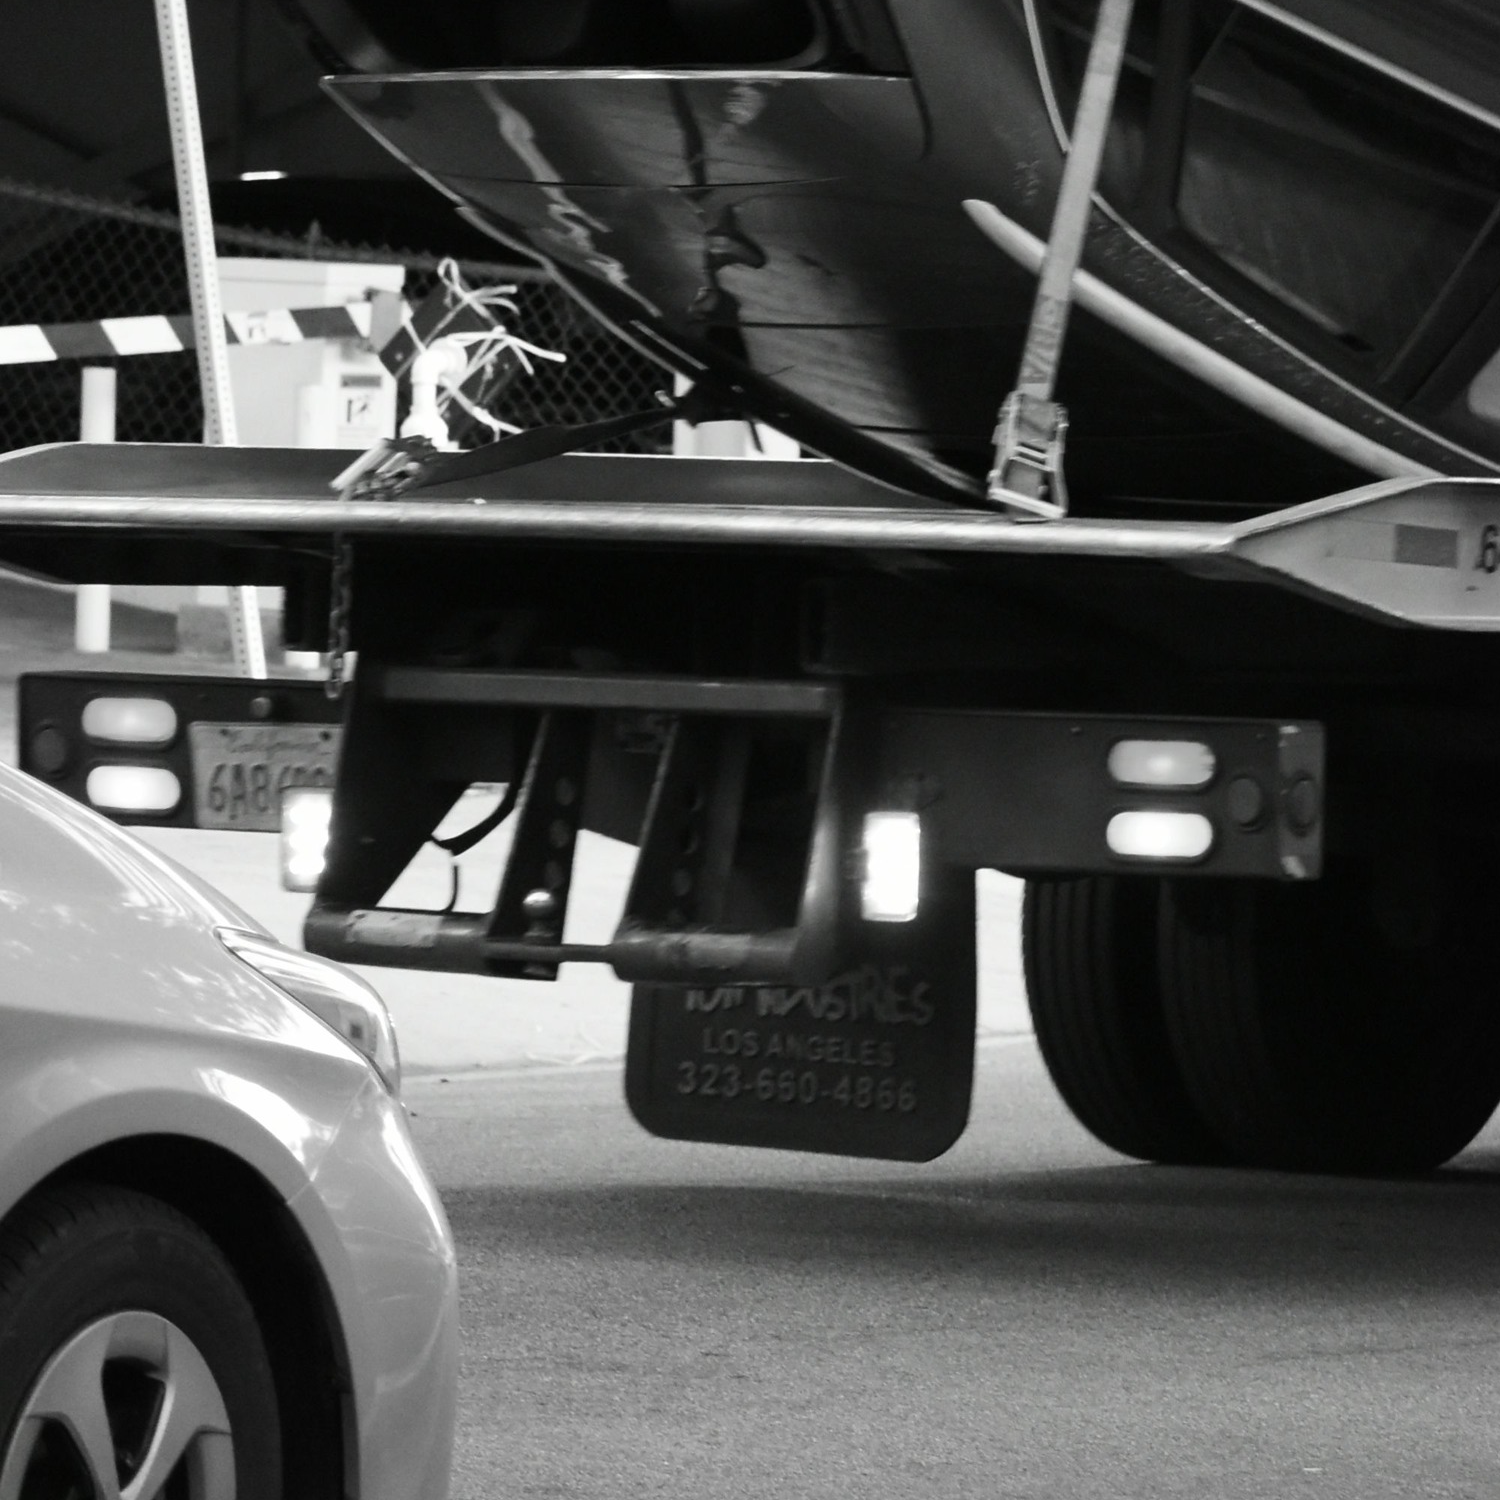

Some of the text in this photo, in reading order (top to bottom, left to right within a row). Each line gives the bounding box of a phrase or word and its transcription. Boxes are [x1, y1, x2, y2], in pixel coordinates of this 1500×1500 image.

[703, 1027, 895, 1067] LOS ANGELES
[677, 1061, 918, 1112] 323-660-4866
